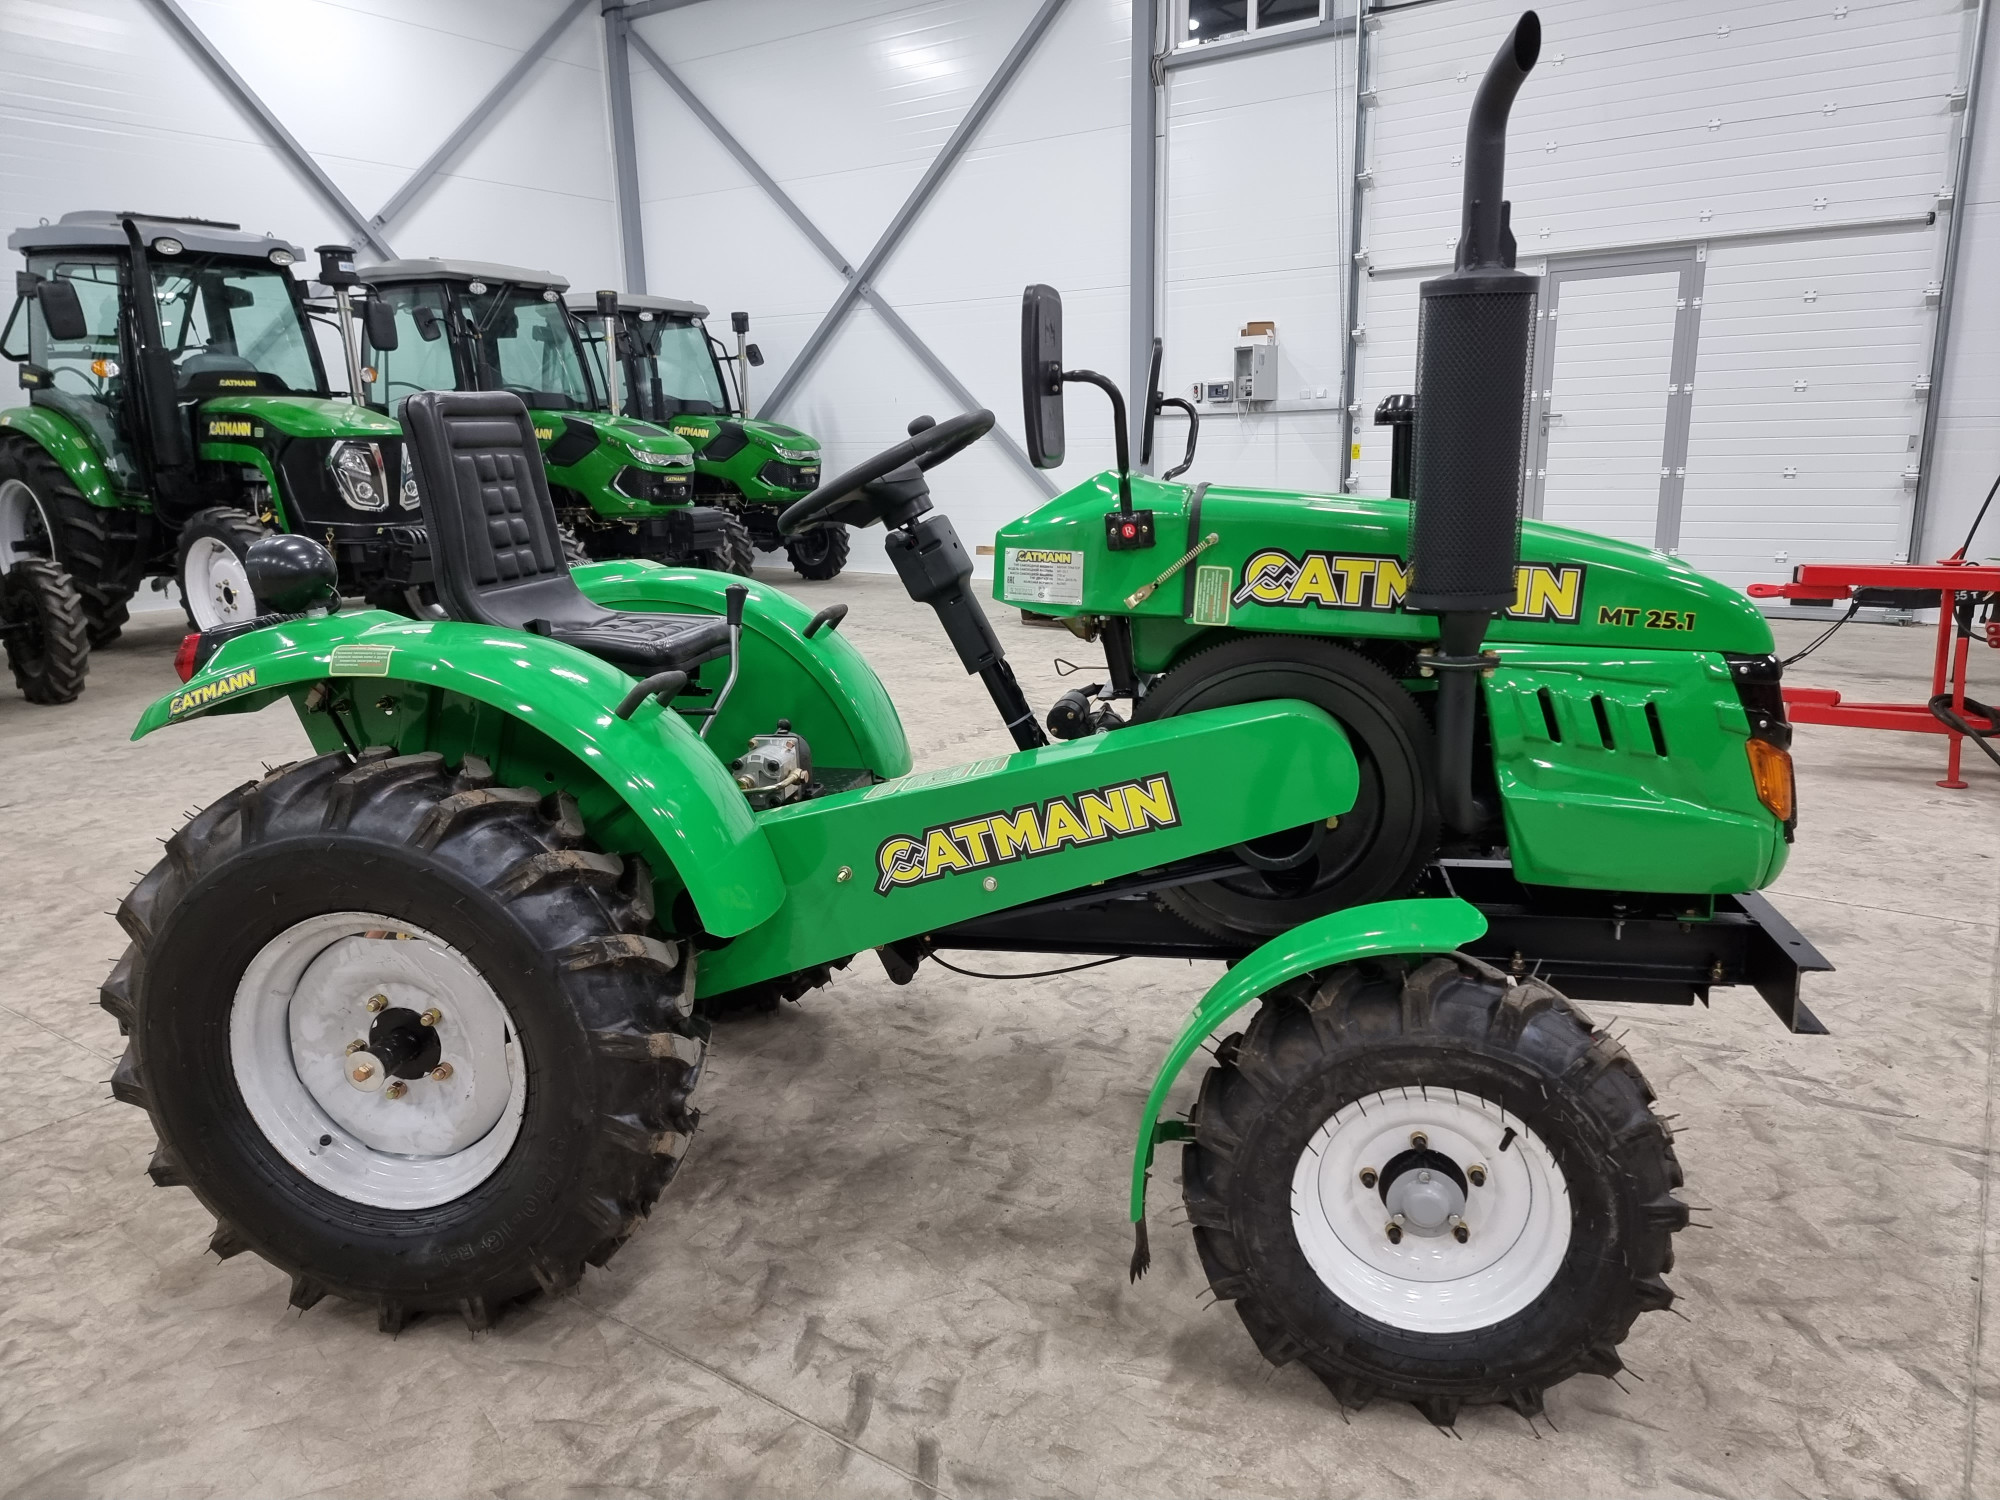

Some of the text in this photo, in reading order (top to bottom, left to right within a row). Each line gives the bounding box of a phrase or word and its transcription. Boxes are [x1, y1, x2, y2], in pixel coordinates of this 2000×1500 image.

[218, 379, 257, 387] CATMANN
[208, 421, 252, 437] CATMANN
[674, 426, 710, 439] CATMANN
[1015, 550, 1072, 564] CATMANN
[1232, 551, 1582, 620] CATMN
[1598, 606, 1696, 632] MT 25.1
[168, 667, 257, 718] CATMANN
[875, 775, 1178, 892] CATMANN
